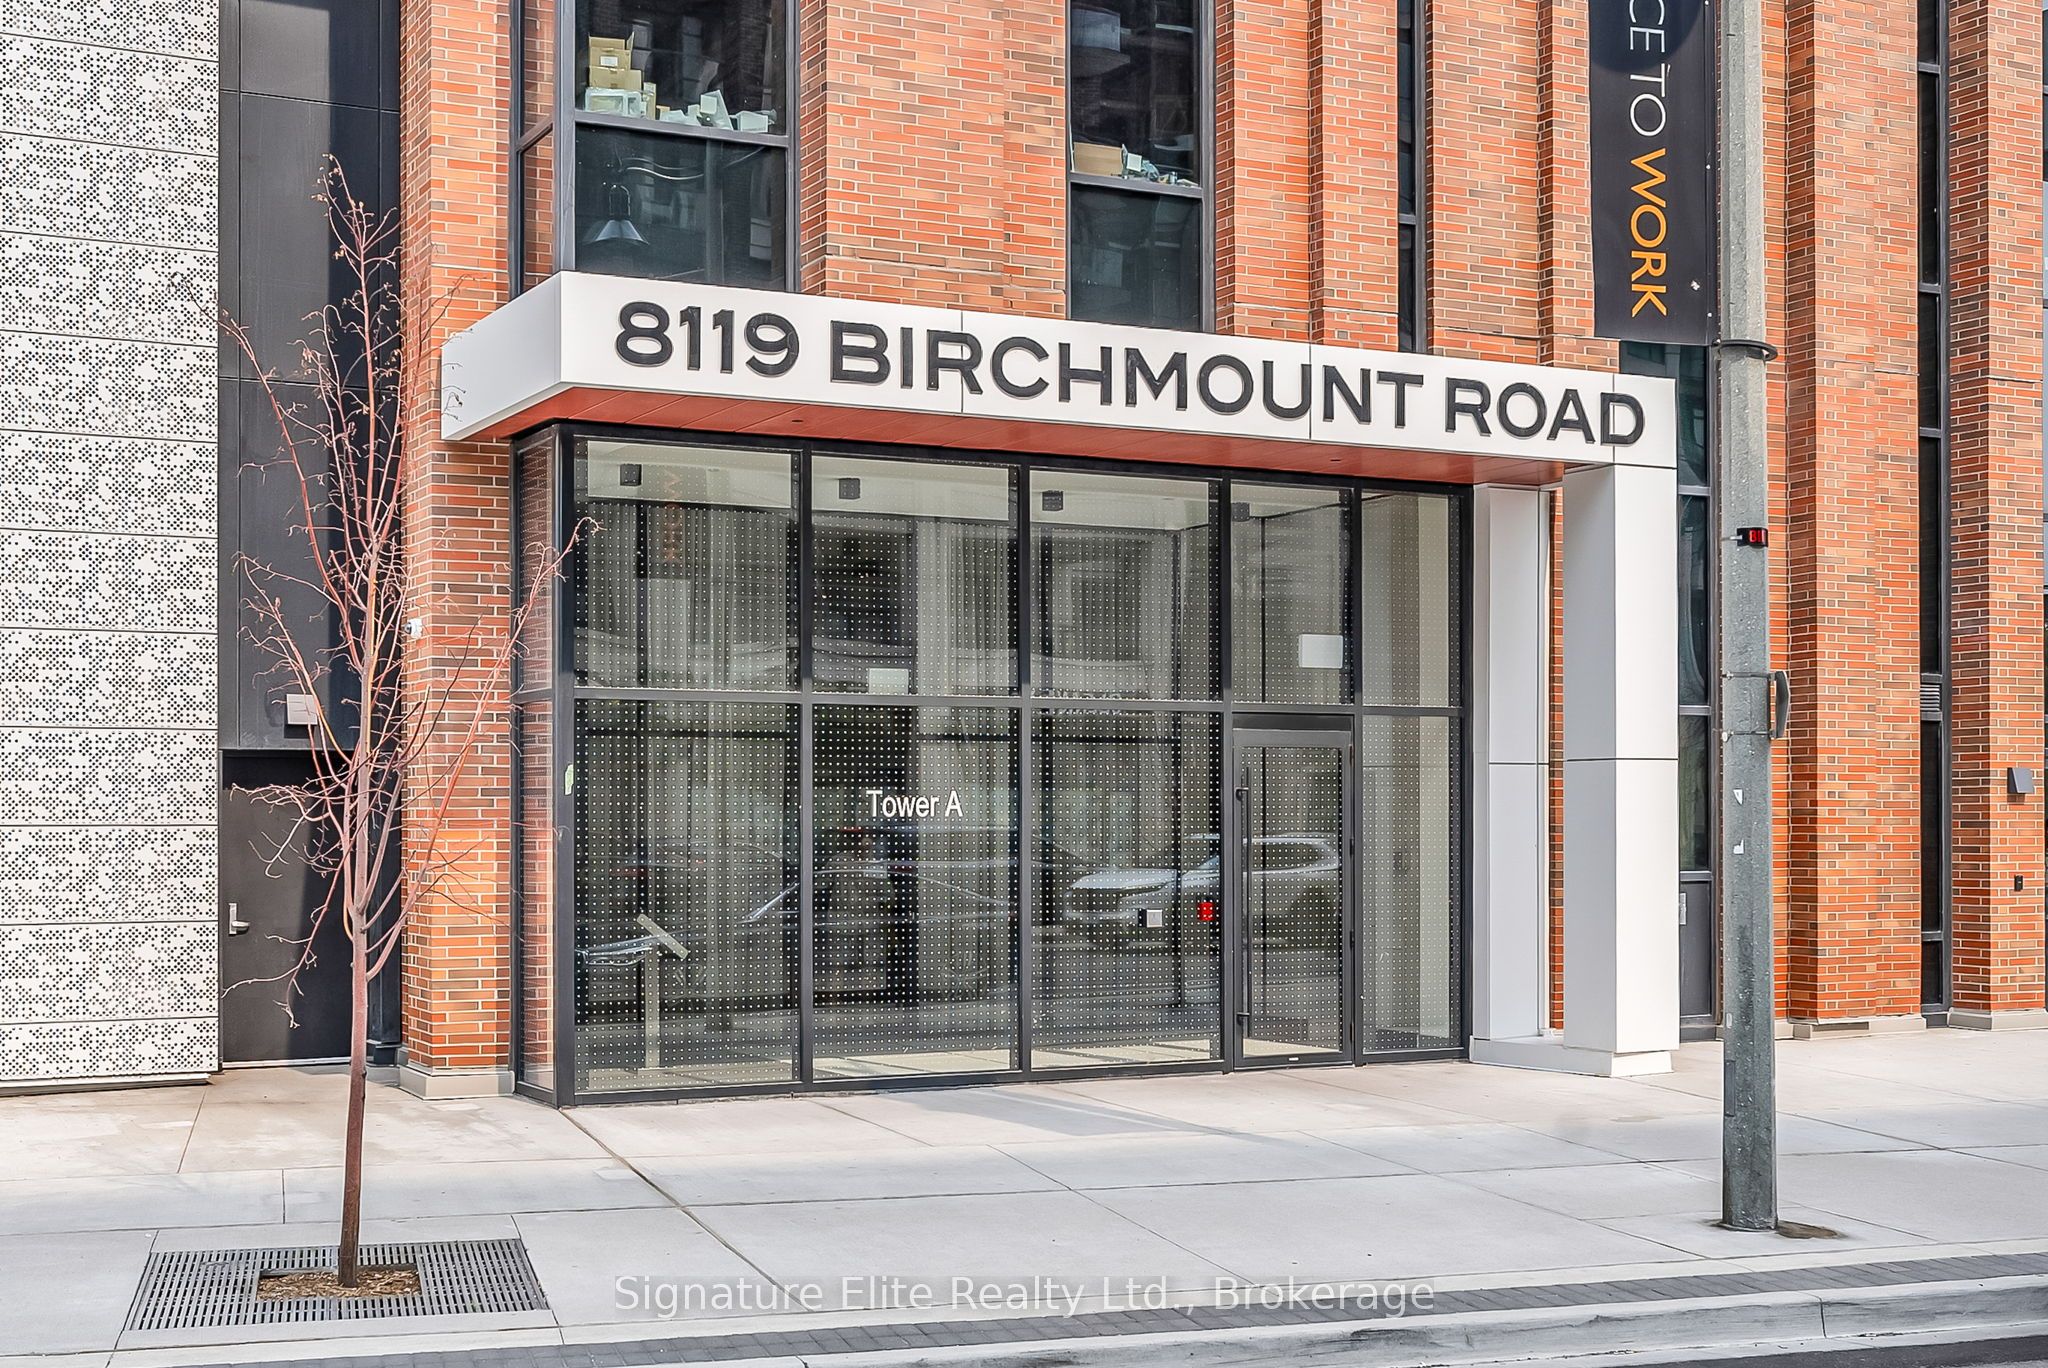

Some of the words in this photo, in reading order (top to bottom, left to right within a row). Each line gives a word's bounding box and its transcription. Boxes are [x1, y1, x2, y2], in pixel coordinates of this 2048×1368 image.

[1630, 63, 1667, 137] TO
[1630, 148, 1668, 318] WORK
[615, 300, 800, 378] 8119
[829, 319, 1425, 429] BIRCHMOUNT
[1444, 376, 1646, 447] ROAD
[865, 789, 940, 818] Tower
[944, 790, 964, 817] A
